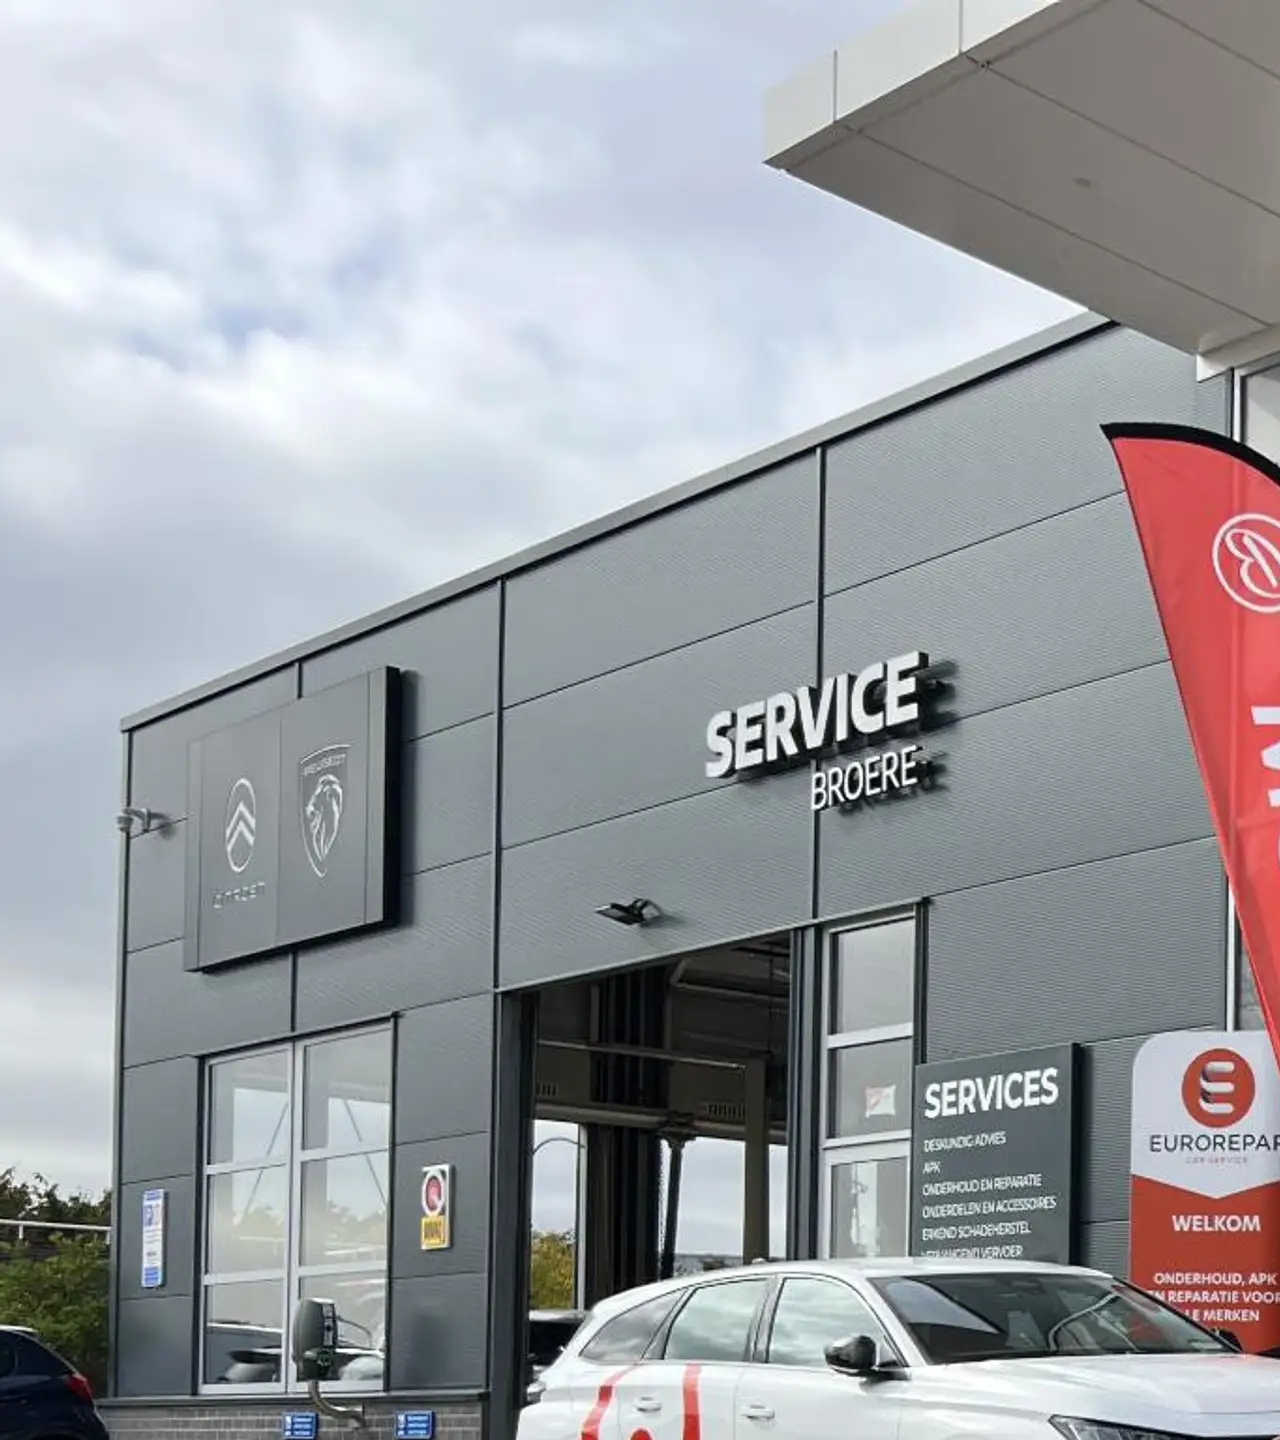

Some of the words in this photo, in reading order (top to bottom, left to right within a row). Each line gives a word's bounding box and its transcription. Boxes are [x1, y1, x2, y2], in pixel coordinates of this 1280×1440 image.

[705, 651, 921, 778] SERVICE
[811, 745, 919, 811] BROERE
[924, 1067, 1059, 1118] SERVICES
[1172, 1215, 1262, 1232] WELKOM
[1154, 1272, 1246, 1287] ONDERHOUD,
[1249, 1273, 1278, 1286] APK
[1168, 1291, 1240, 1304] REPARATIE
[1203, 1309, 1260, 1322] MERKEN
